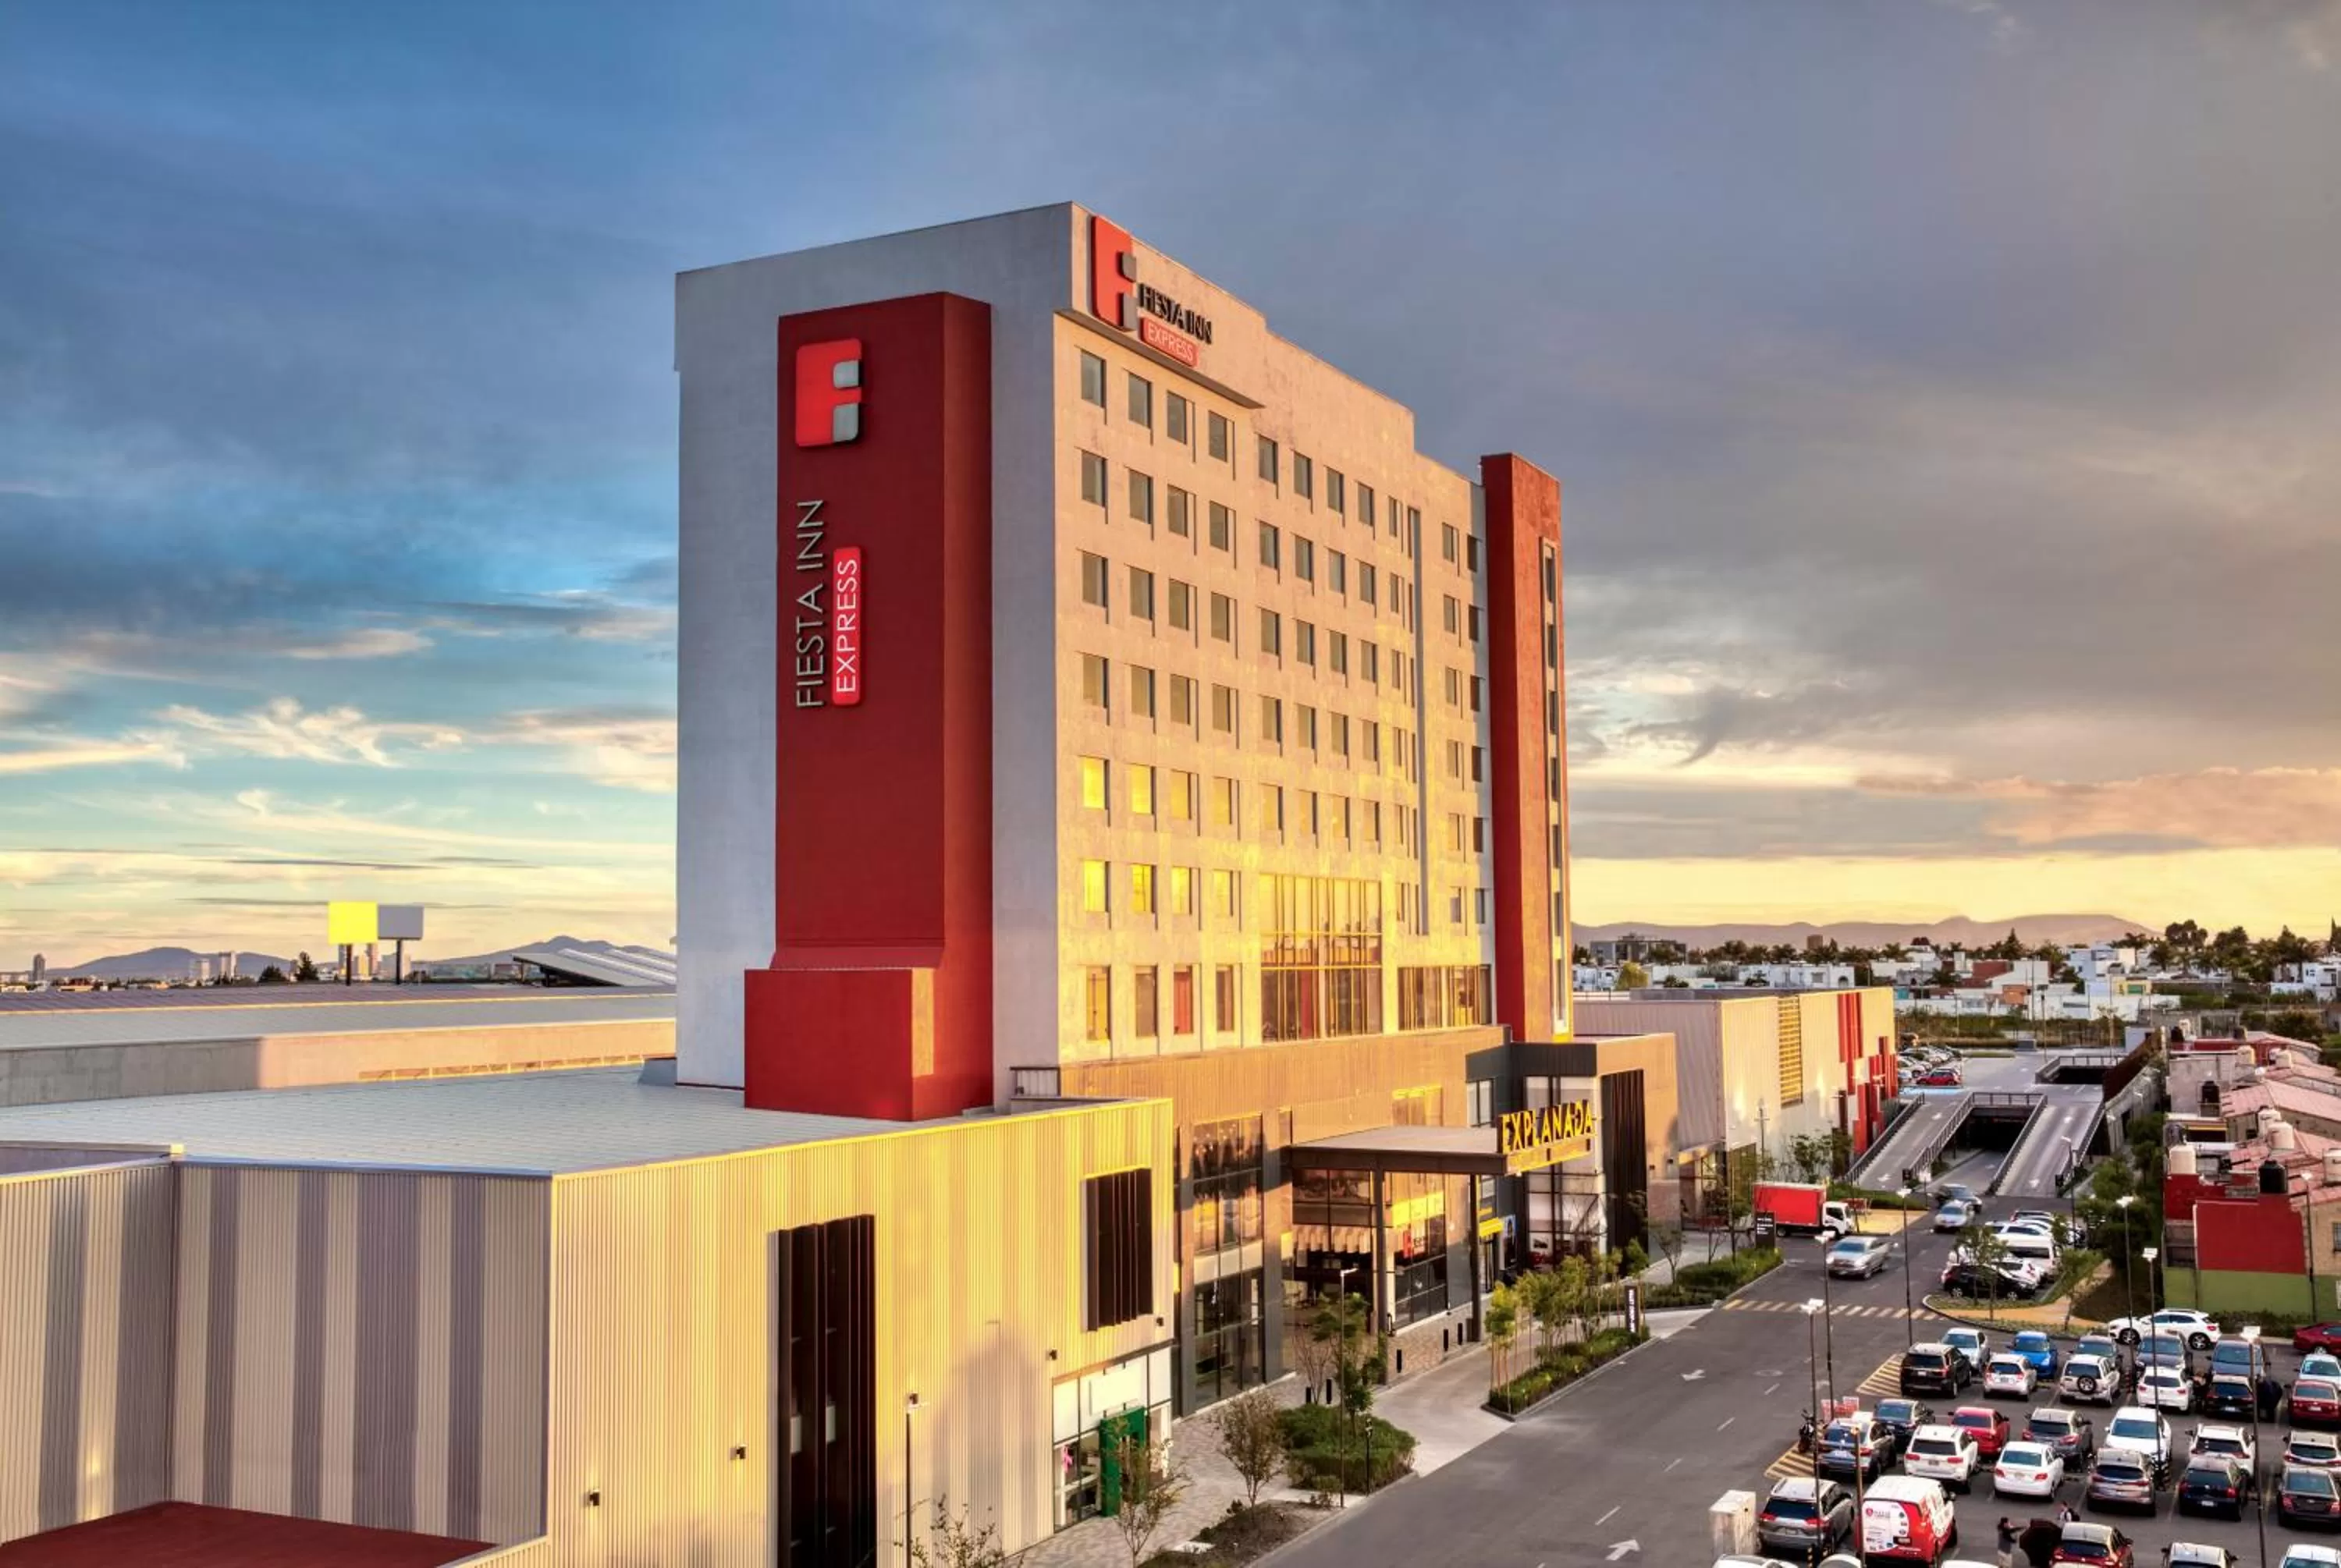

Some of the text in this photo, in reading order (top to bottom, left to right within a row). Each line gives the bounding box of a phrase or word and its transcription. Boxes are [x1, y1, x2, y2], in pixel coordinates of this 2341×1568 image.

[1139, 283, 1212, 345] FIESTA INN
[1147, 321, 1193, 361] EXPRESS
[796, 499, 824, 708] FIESTA INN
[836, 559, 858, 693] EXPRESS
[1499, 1100, 1593, 1155] EXPLANADA
